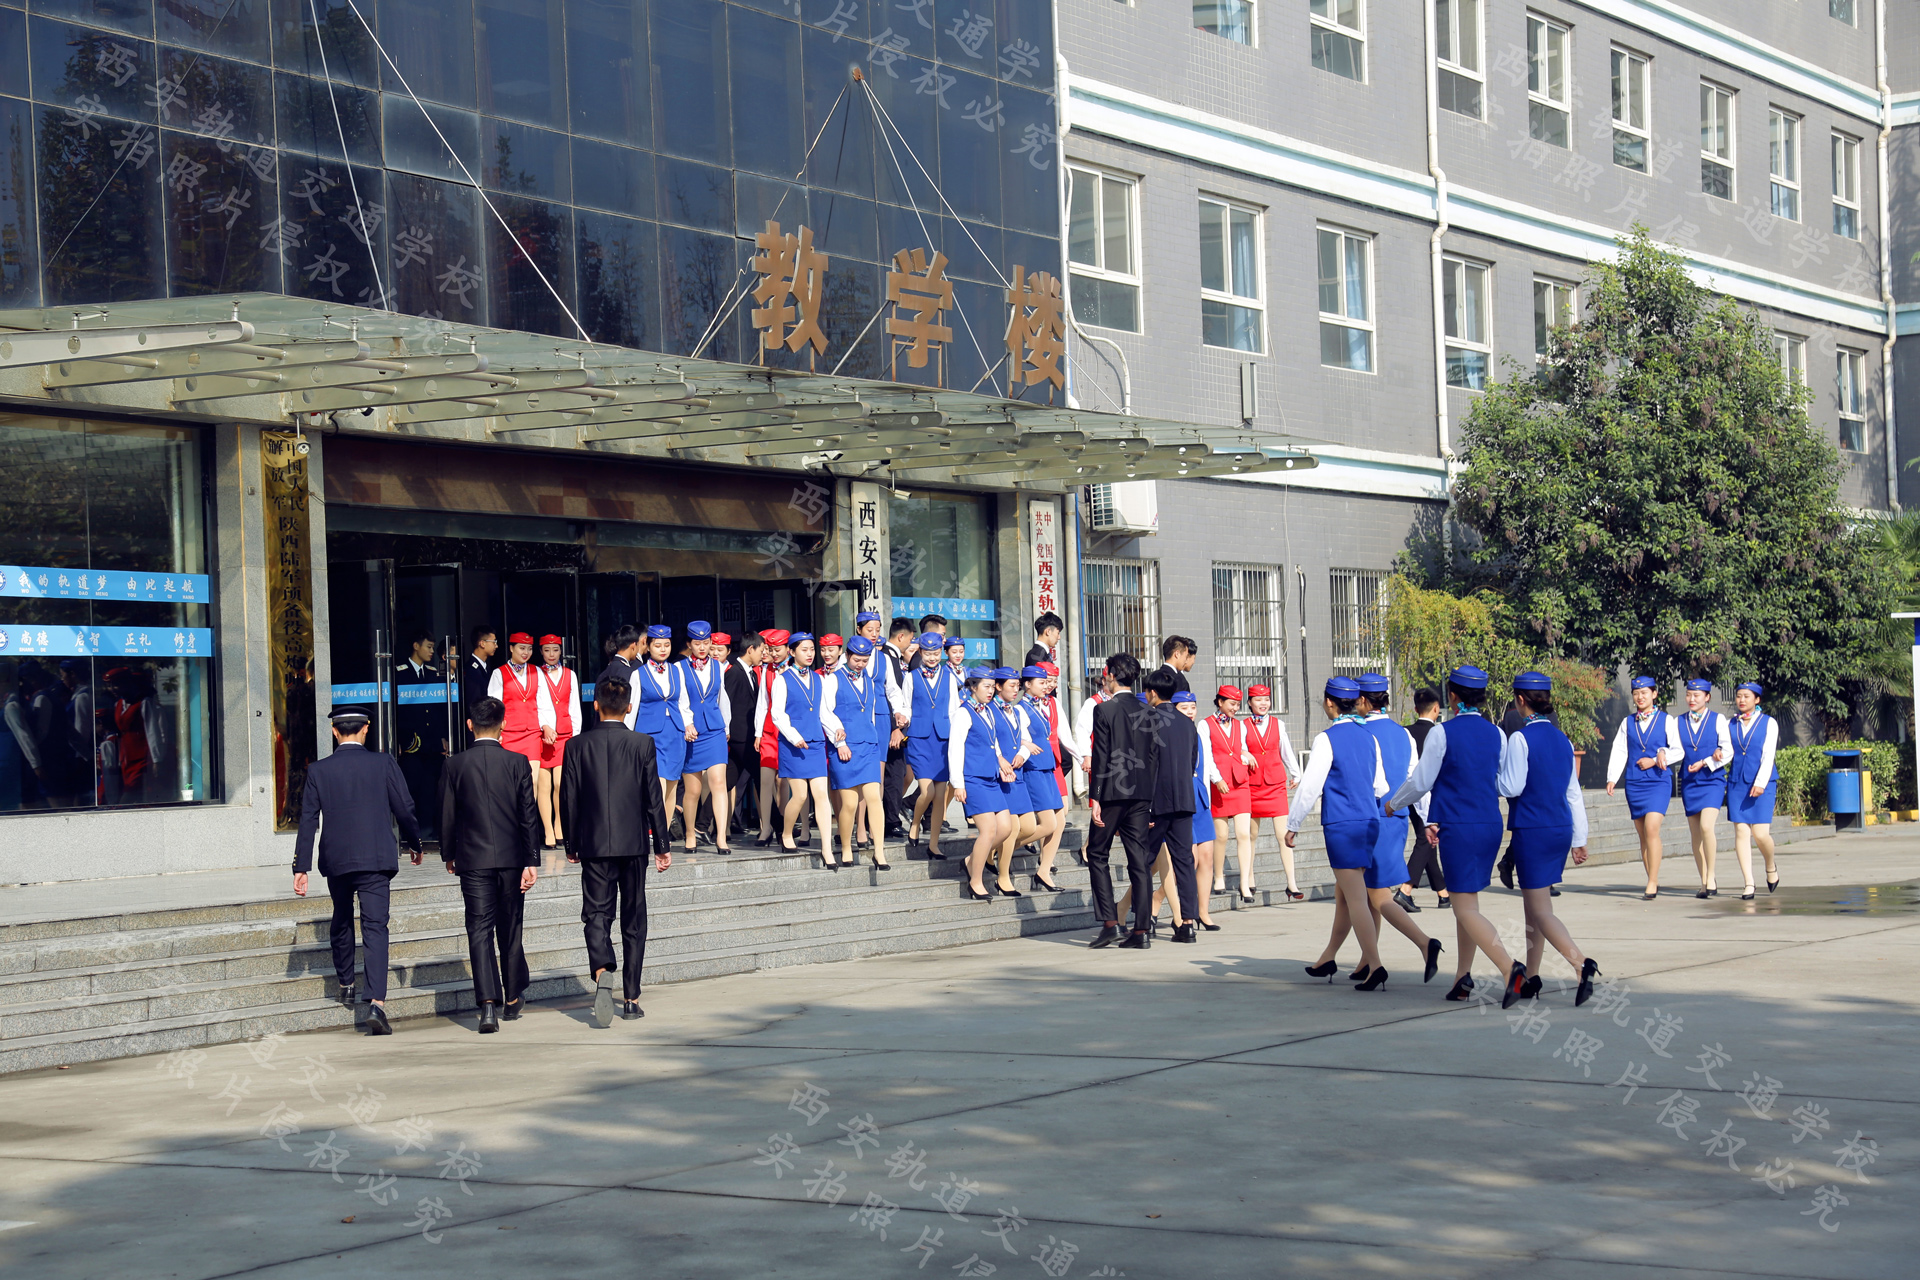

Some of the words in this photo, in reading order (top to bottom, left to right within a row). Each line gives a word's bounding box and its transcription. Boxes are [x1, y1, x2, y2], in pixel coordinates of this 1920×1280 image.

[751, 219, 1065, 391] 教学楼
[18, 571, 108, 591] 我的轨道梦
[127, 576, 194, 593] 由此起航
[858, 500, 879, 613] 西安轨
[1038, 561, 1055, 615] 西安轨
[21, 630, 49, 646] 尚德
[75, 631, 100, 647] 启智
[125, 632, 152, 647] 正礼
[174, 632, 196, 649] 修身
